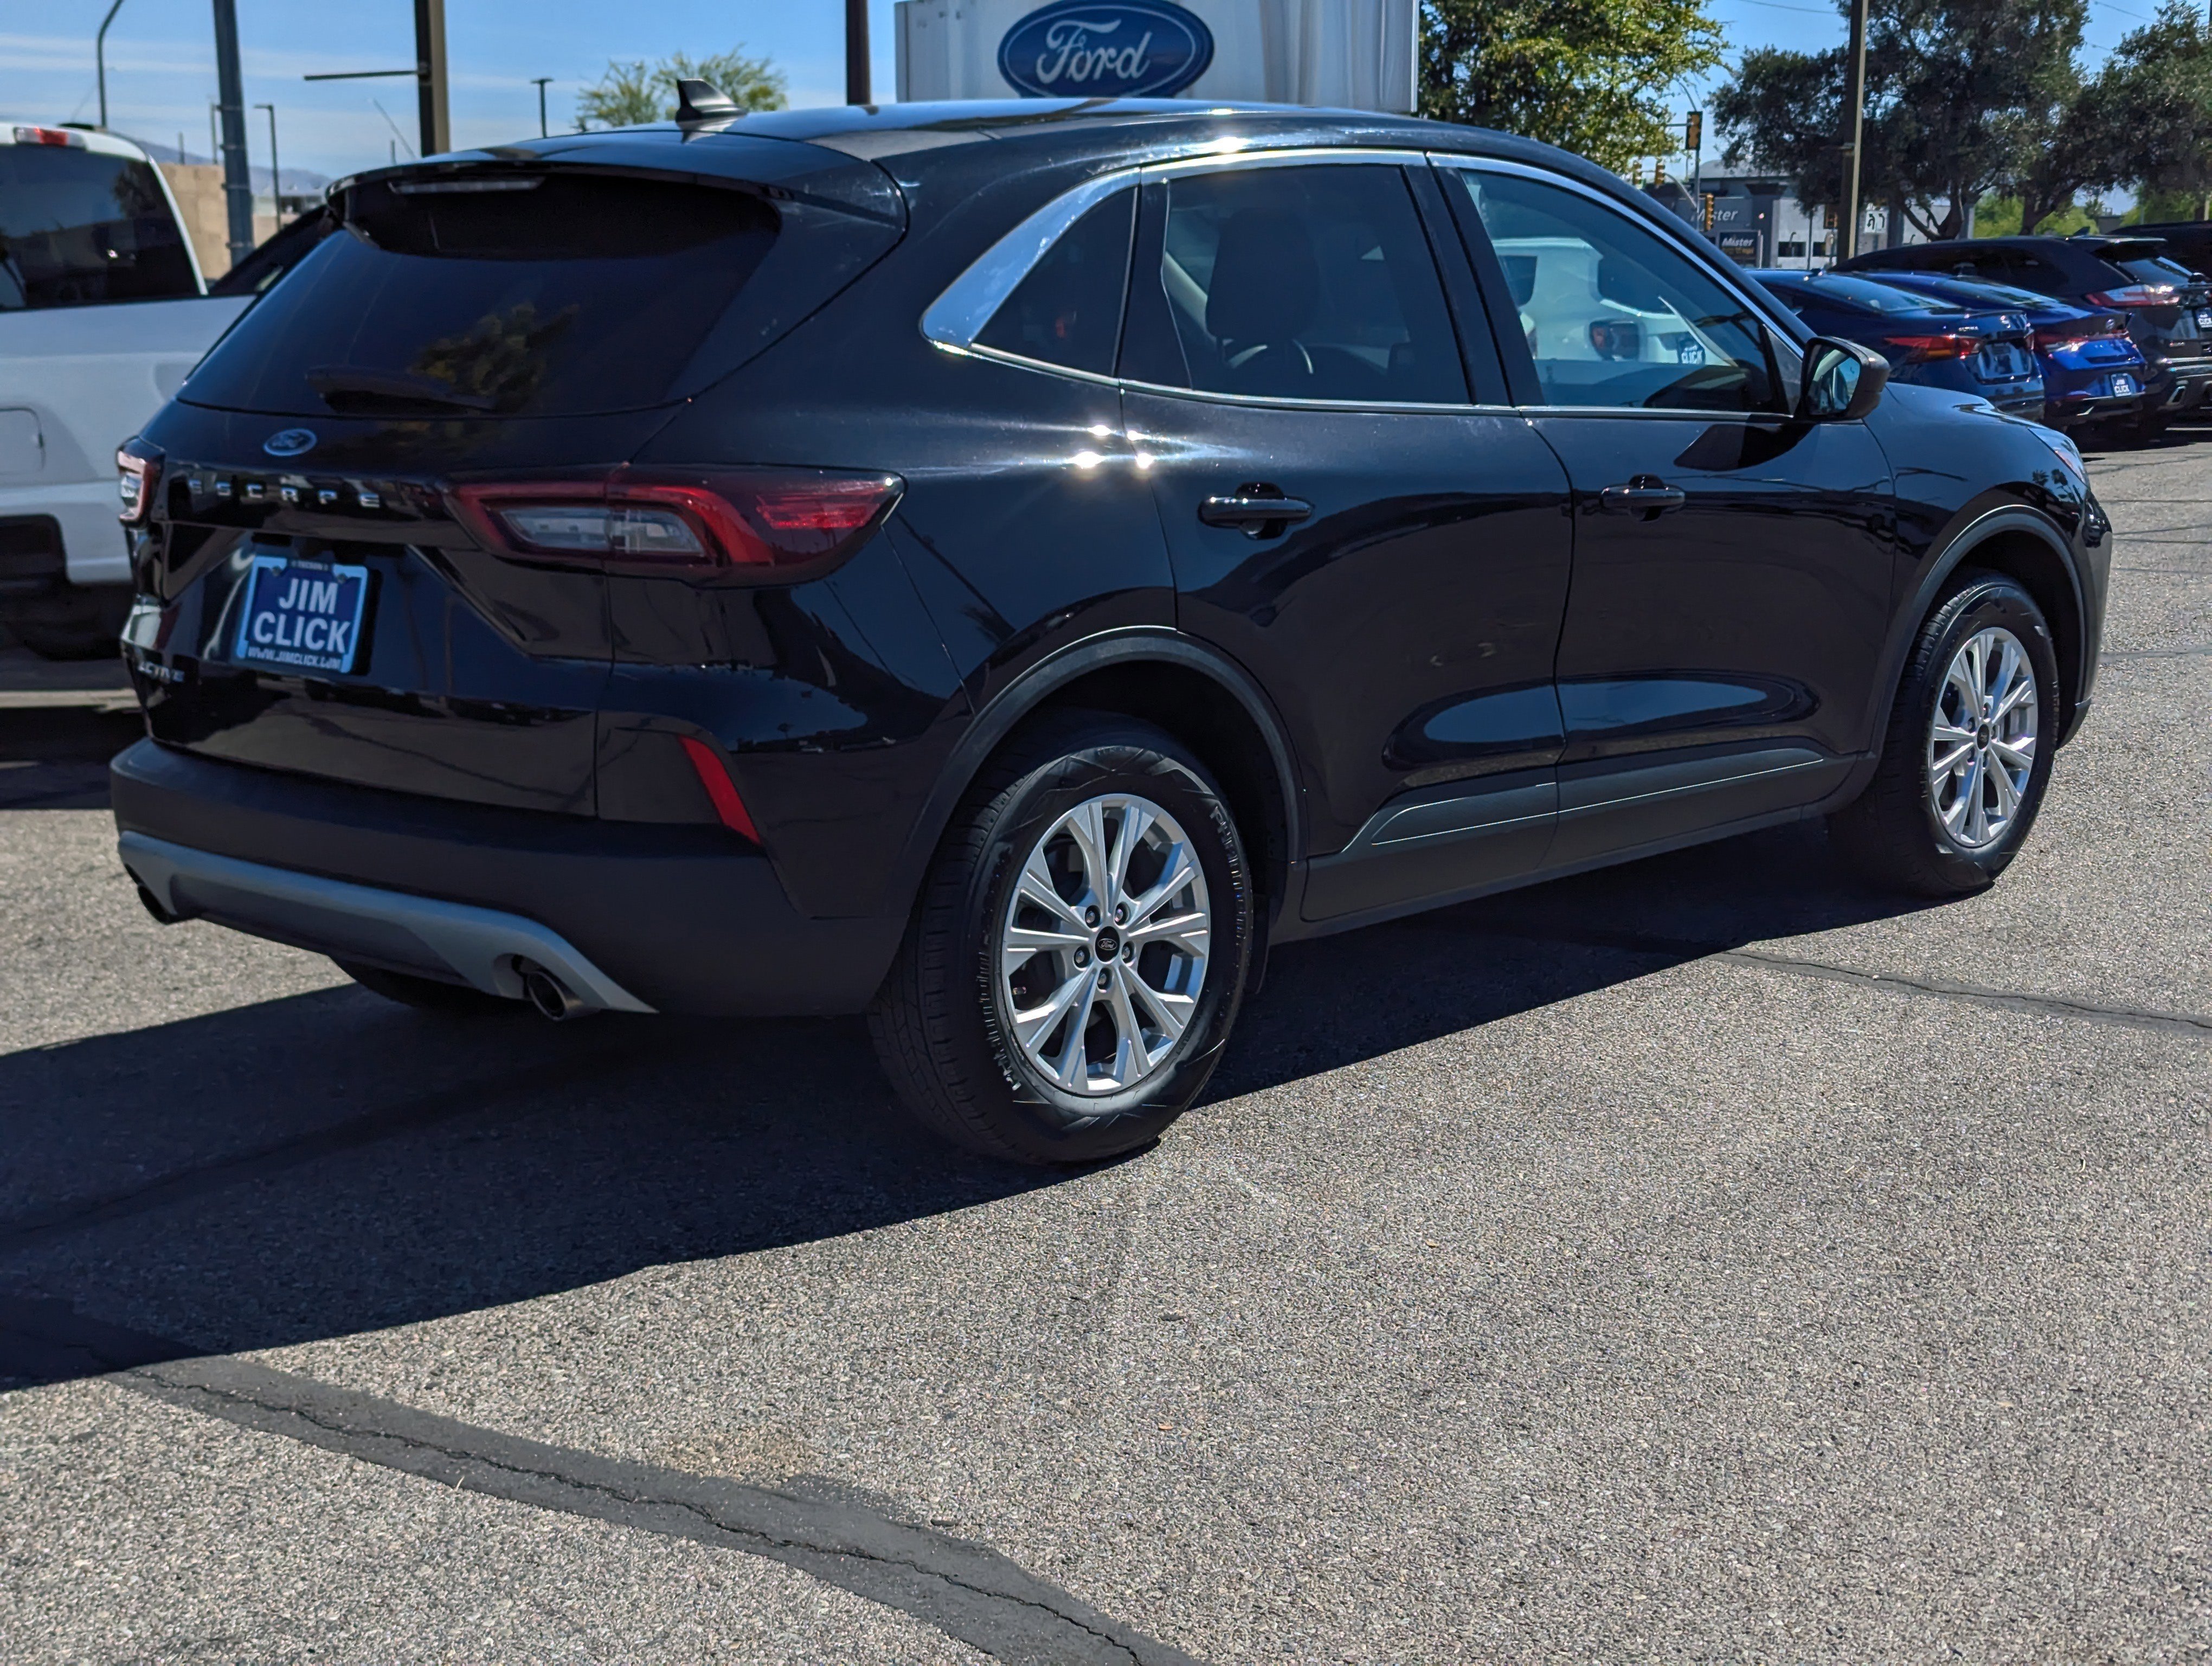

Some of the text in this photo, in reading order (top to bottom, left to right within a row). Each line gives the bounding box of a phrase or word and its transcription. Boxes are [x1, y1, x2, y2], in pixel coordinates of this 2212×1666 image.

[1036, 19, 1153, 84] Ford
[1690, 208, 1738, 221] Mster
[1722, 238, 1754, 247] Mister
[189, 479, 380, 508] ESCAPE
[278, 578, 338, 614] JIM
[254, 613, 351, 653] CLICK
